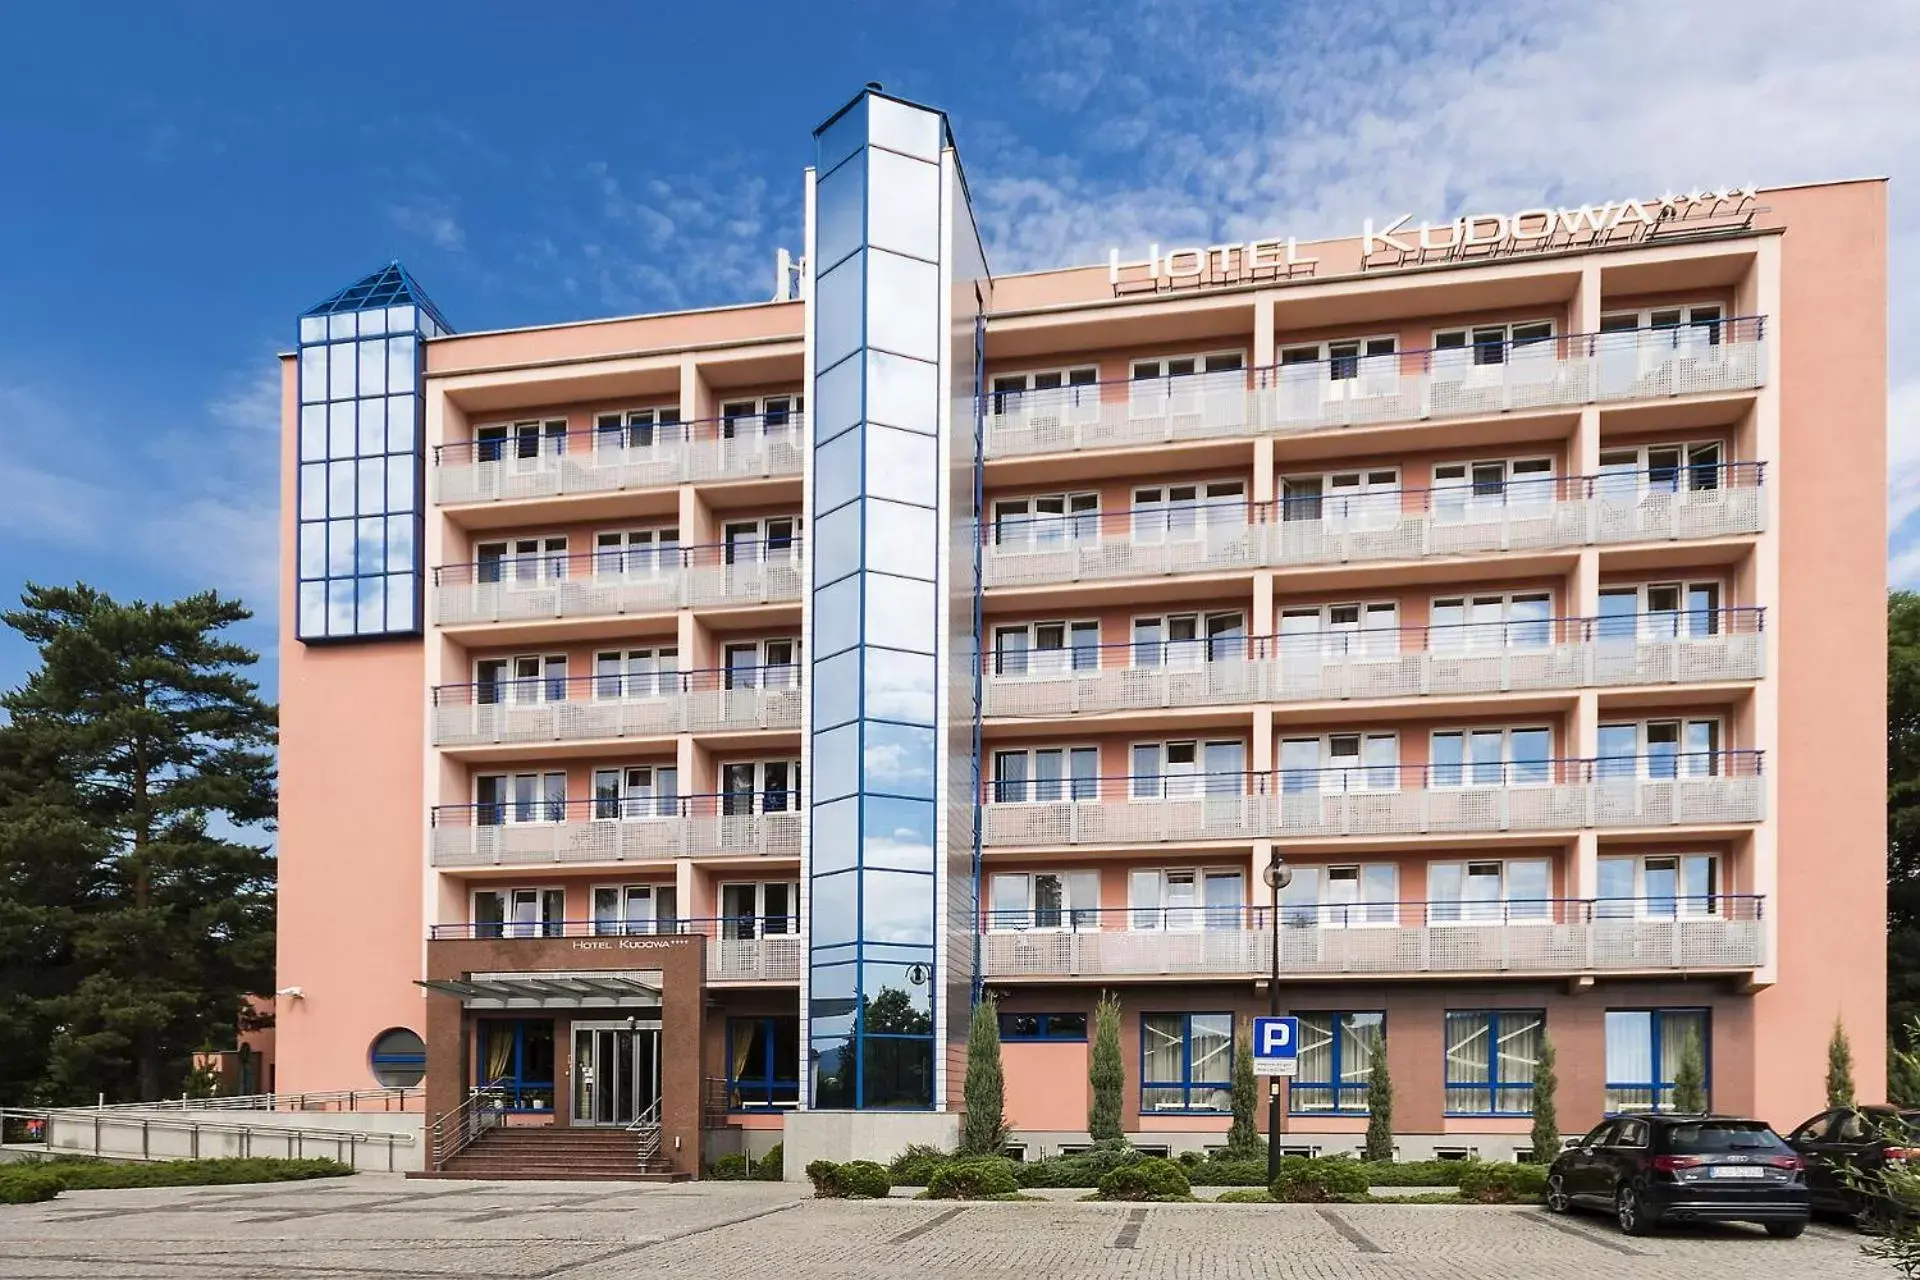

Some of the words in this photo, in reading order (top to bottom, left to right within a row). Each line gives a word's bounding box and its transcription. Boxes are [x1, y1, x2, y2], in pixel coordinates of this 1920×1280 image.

[1108, 237, 1318, 284] HOTEL
[573, 940, 612, 949] HOTEL
[1263, 1023, 1289, 1054] P
